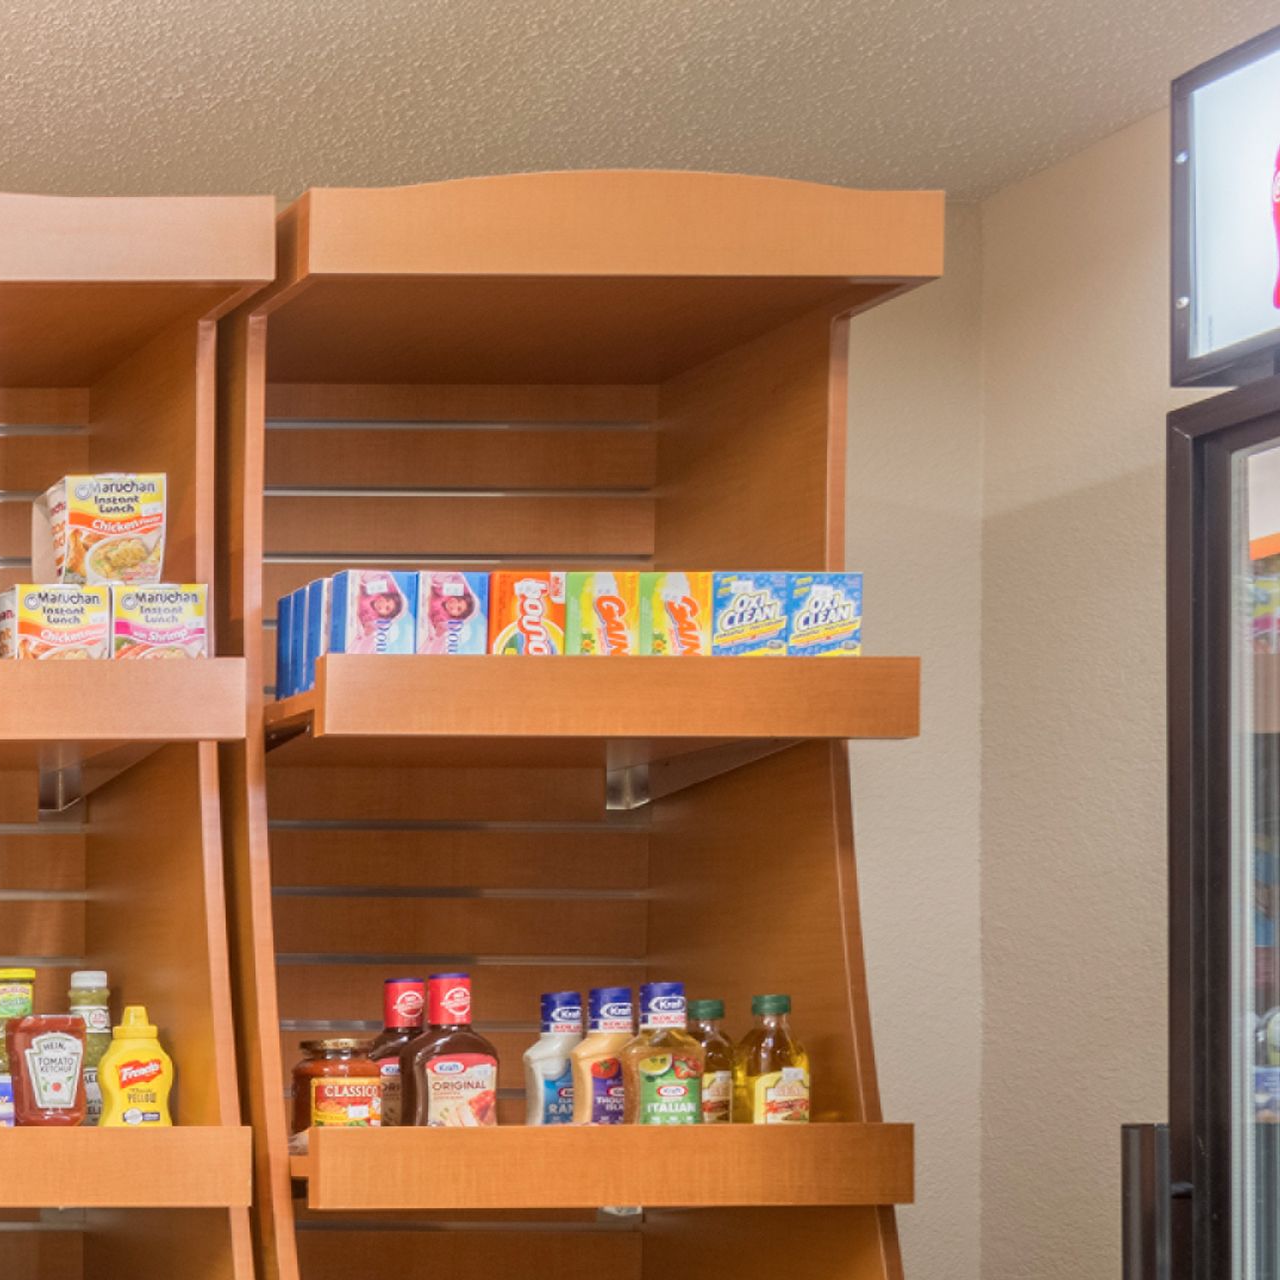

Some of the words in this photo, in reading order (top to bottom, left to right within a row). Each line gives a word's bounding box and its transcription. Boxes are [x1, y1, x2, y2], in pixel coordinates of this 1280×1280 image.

[91, 480, 156, 494] Maruchan
[94, 495, 139, 504] Instant
[98, 503, 136, 514] Lunch
[92, 517, 137, 532] Chicken
[38, 591, 101, 606] Maruchan
[135, 591, 198, 605] Maruchan
[737, 595, 764, 612] OXI
[42, 606, 85, 616] Instant
[140, 606, 183, 615] Instant
[46, 614, 81, 625] Lunch
[145, 614, 179, 625] Lunch
[723, 604, 776, 630] CLEAN
[797, 604, 851, 630] CLEAN
[40, 627, 85, 641] Chicken
[148, 627, 190, 642] Shrimp
[659, 998, 686, 1010] Kraft
[39, 1057, 74, 1067] TOMATO
[40, 1066, 73, 1074] KETCHUP
[324, 1084, 379, 1098] CLASSICO
[432, 1080, 487, 1092] ORIGINAL
[647, 1101, 696, 1113] ITALIAN
